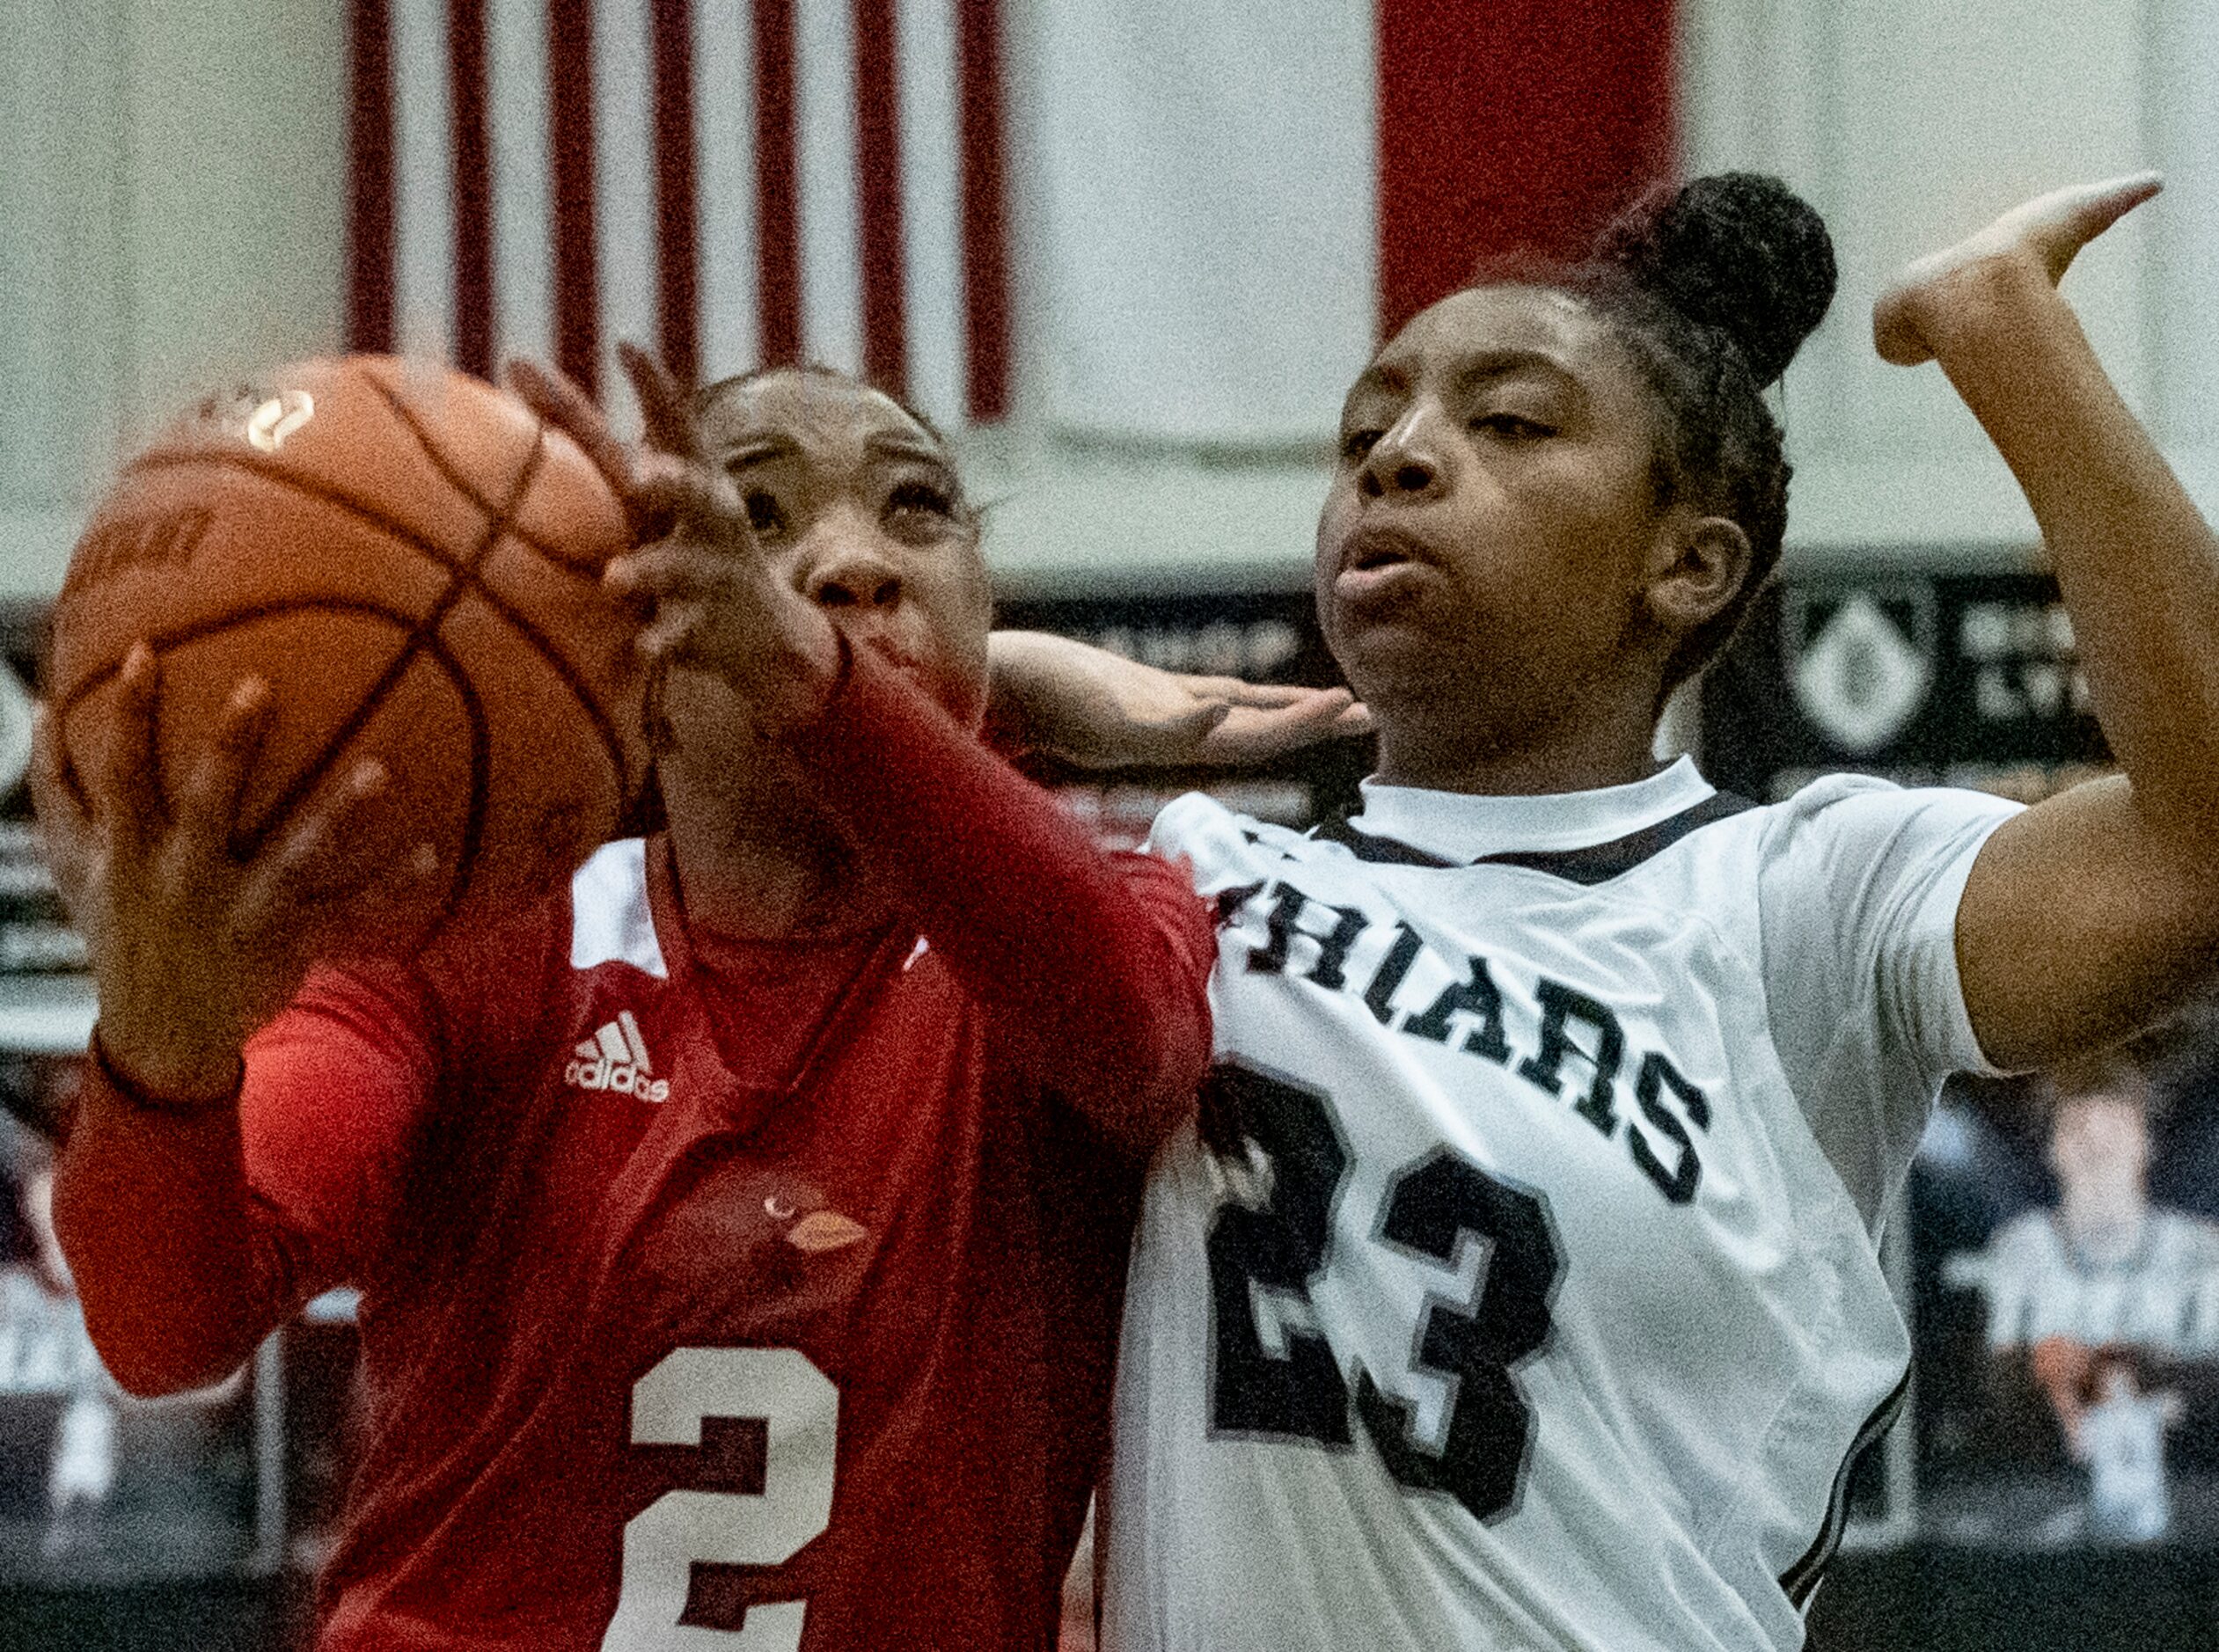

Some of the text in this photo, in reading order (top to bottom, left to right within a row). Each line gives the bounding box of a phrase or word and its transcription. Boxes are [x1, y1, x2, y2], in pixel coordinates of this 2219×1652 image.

[564, 1057, 670, 1104] adidas
[1197, 1061, 1570, 1526] 23
[600, 1346, 840, 1652] 2
